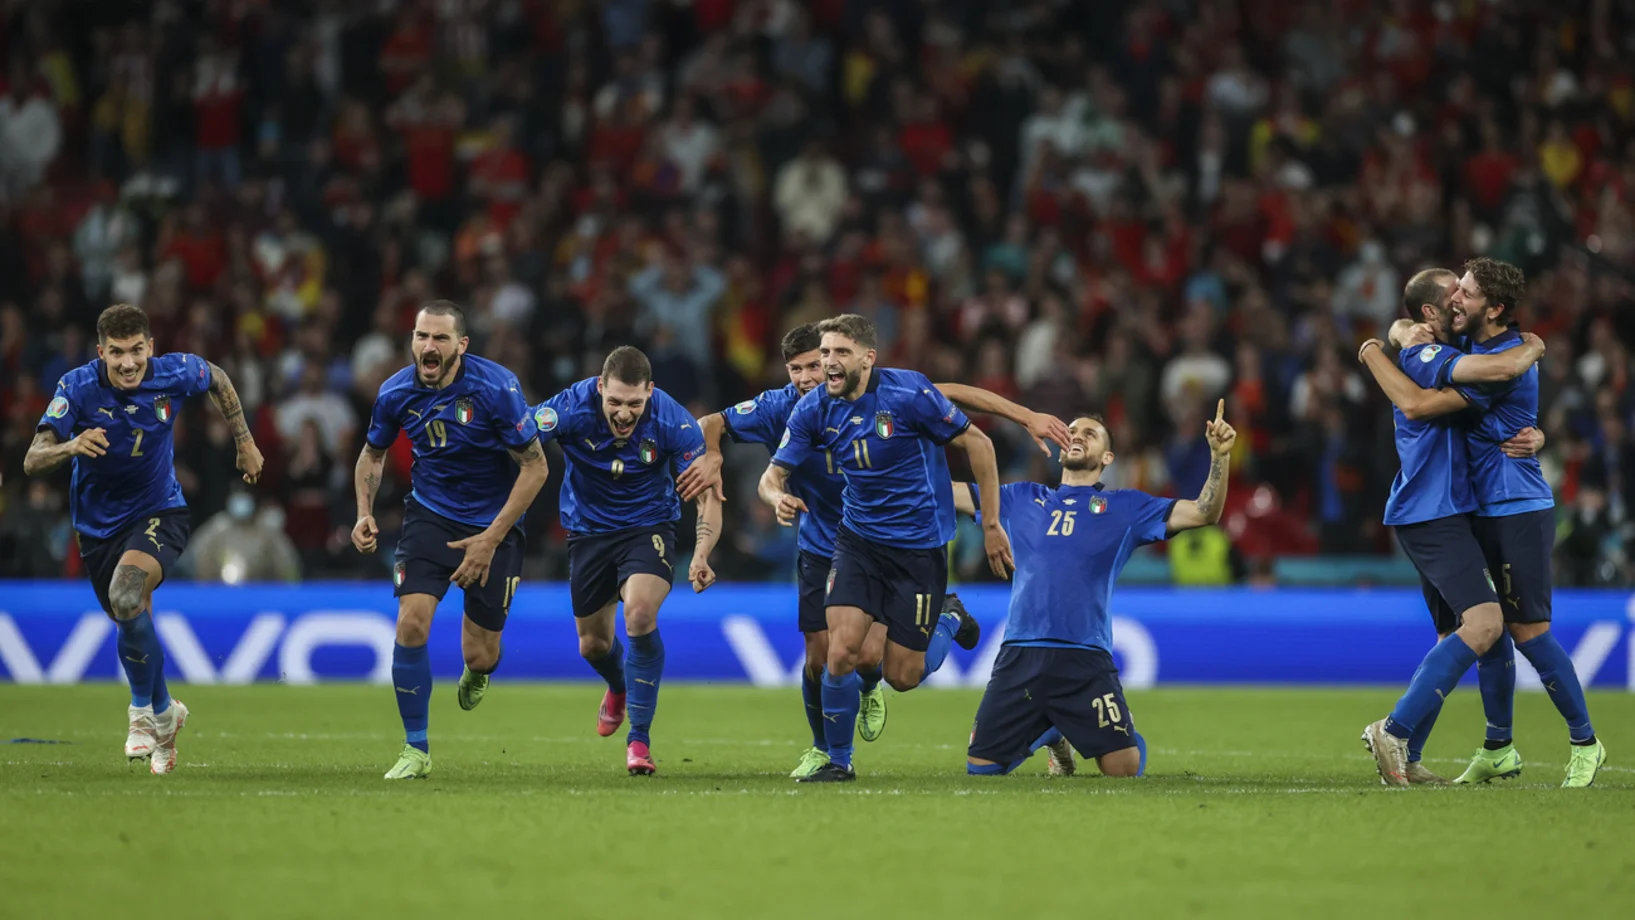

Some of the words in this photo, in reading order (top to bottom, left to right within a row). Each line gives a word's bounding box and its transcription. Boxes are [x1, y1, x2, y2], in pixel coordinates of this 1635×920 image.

[130, 428, 143, 457] 2
[425, 419, 447, 447] 19
[825, 448, 844, 474] 1
[852, 439, 873, 468] 11
[144, 517, 161, 537] 2
[1046, 509, 1077, 536] 25
[651, 534, 665, 557] 9
[1502, 563, 1512, 595] 5
[915, 593, 932, 625] 11
[1091, 692, 1122, 728] 25
